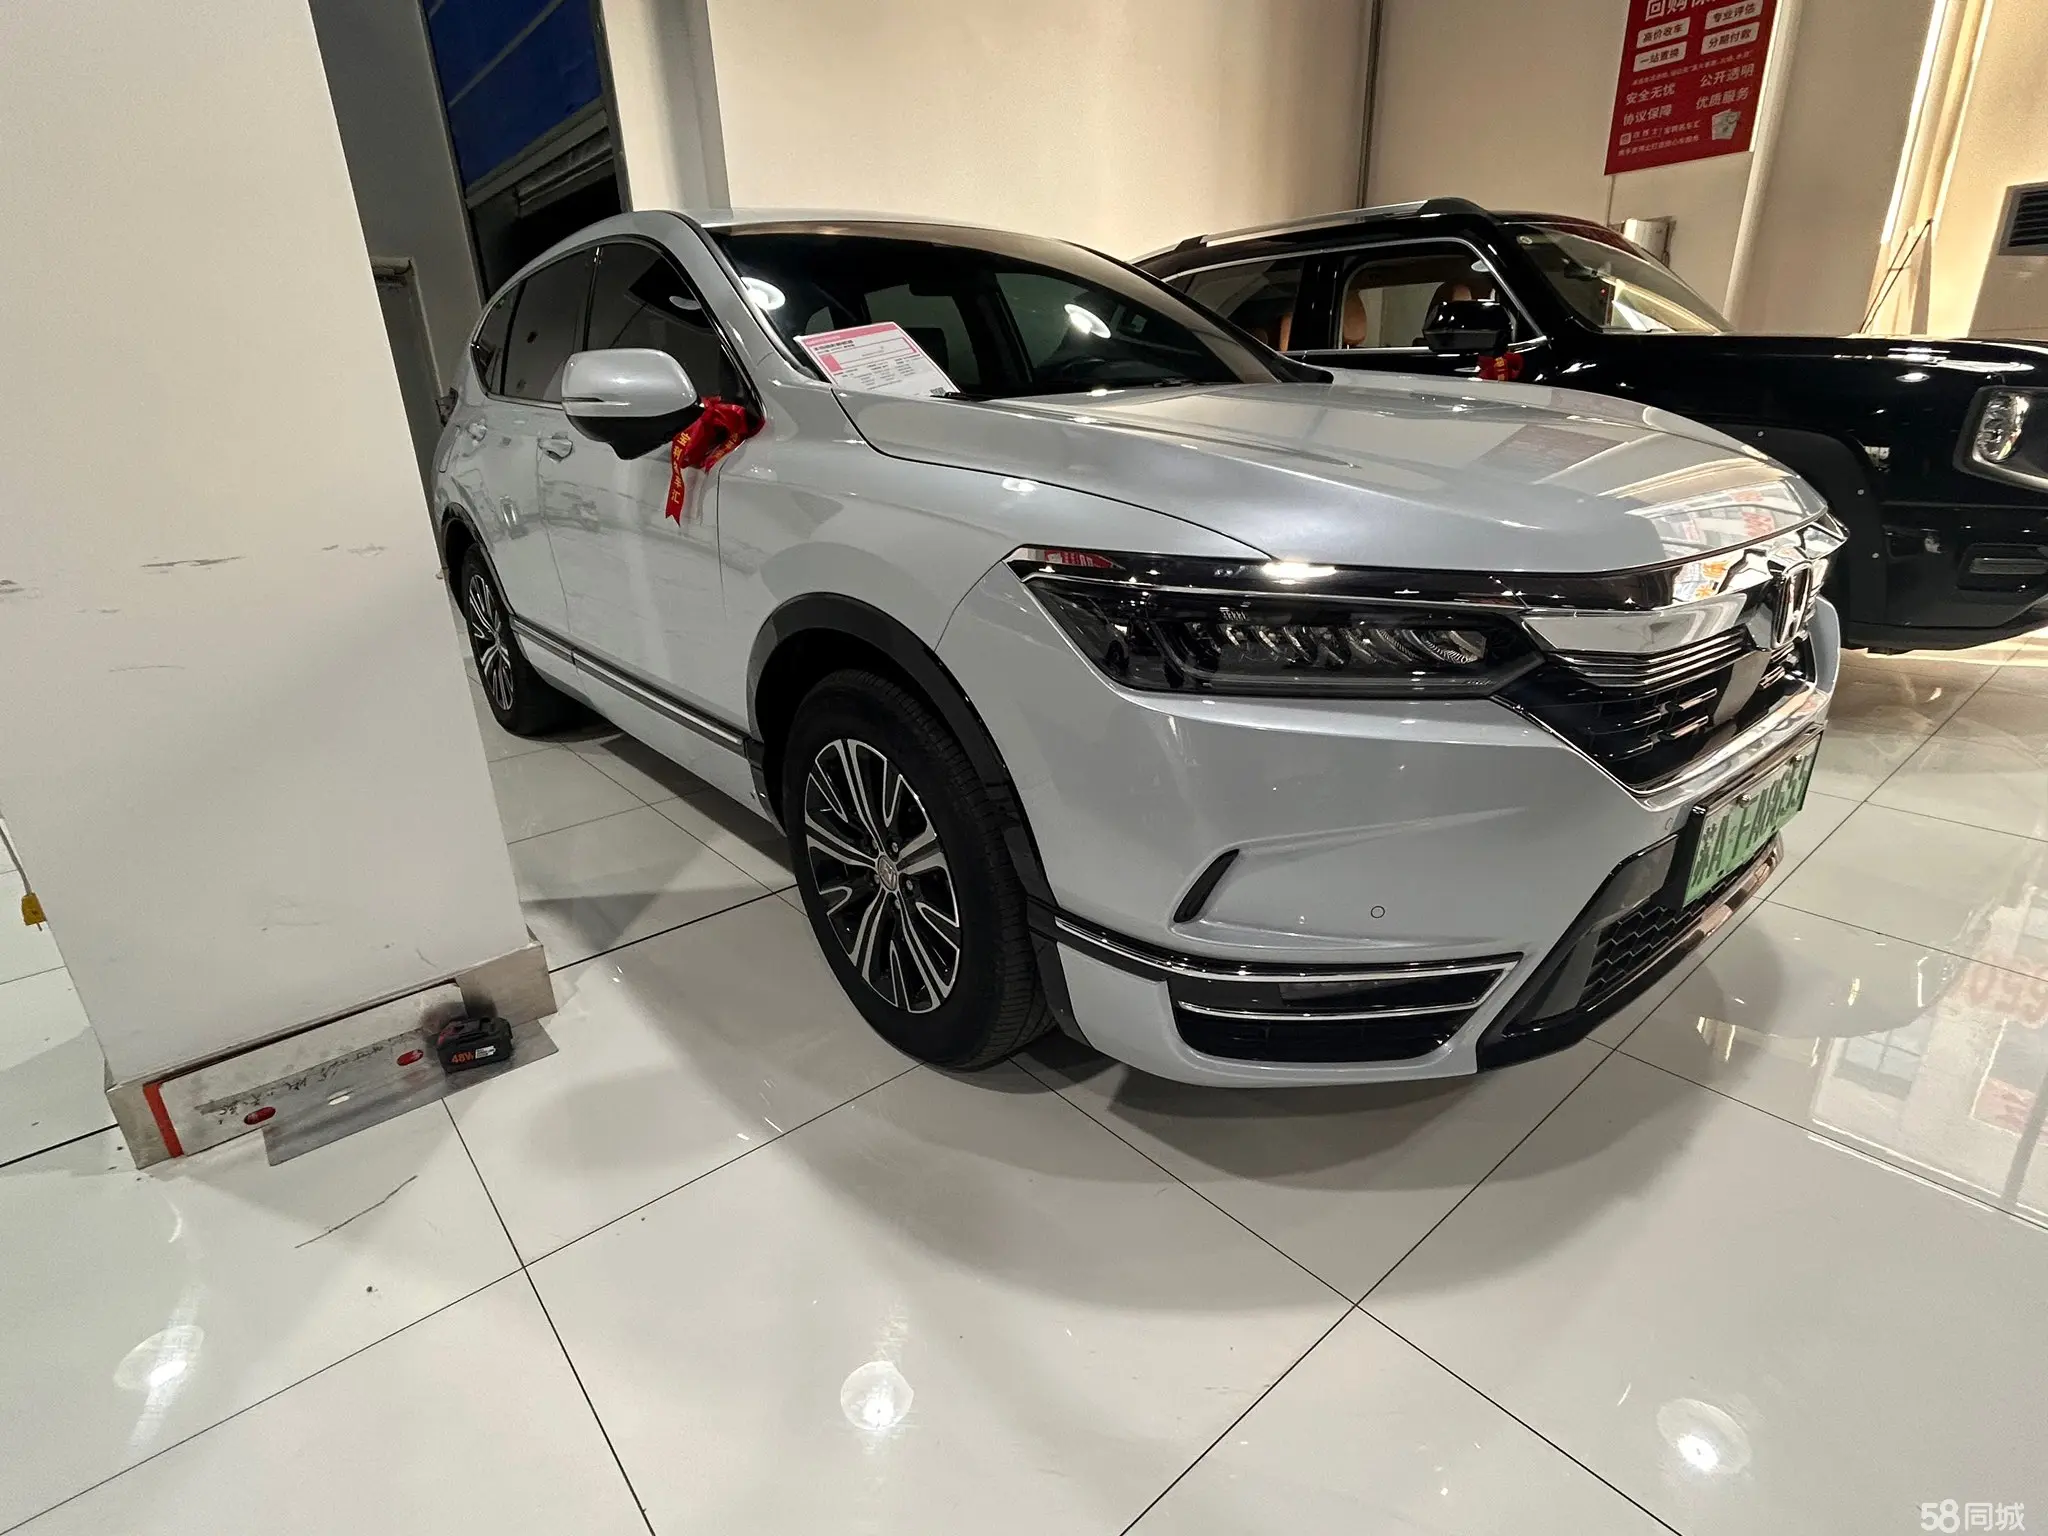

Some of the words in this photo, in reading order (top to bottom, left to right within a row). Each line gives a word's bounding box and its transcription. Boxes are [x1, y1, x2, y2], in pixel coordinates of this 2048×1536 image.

[1712, 3, 1756, 22] 专业评估
[1643, 23, 1685, 43] 高价收车
[1708, 28, 1752, 49] 分期付款
[1640, 48, 1681, 64] 一站置换
[1700, 63, 1755, 88] 公开透明
[1625, 83, 1676, 106] 安全无忧
[1696, 87, 1750, 111] 优质服务
[1623, 104, 1673, 126] 协议保障
